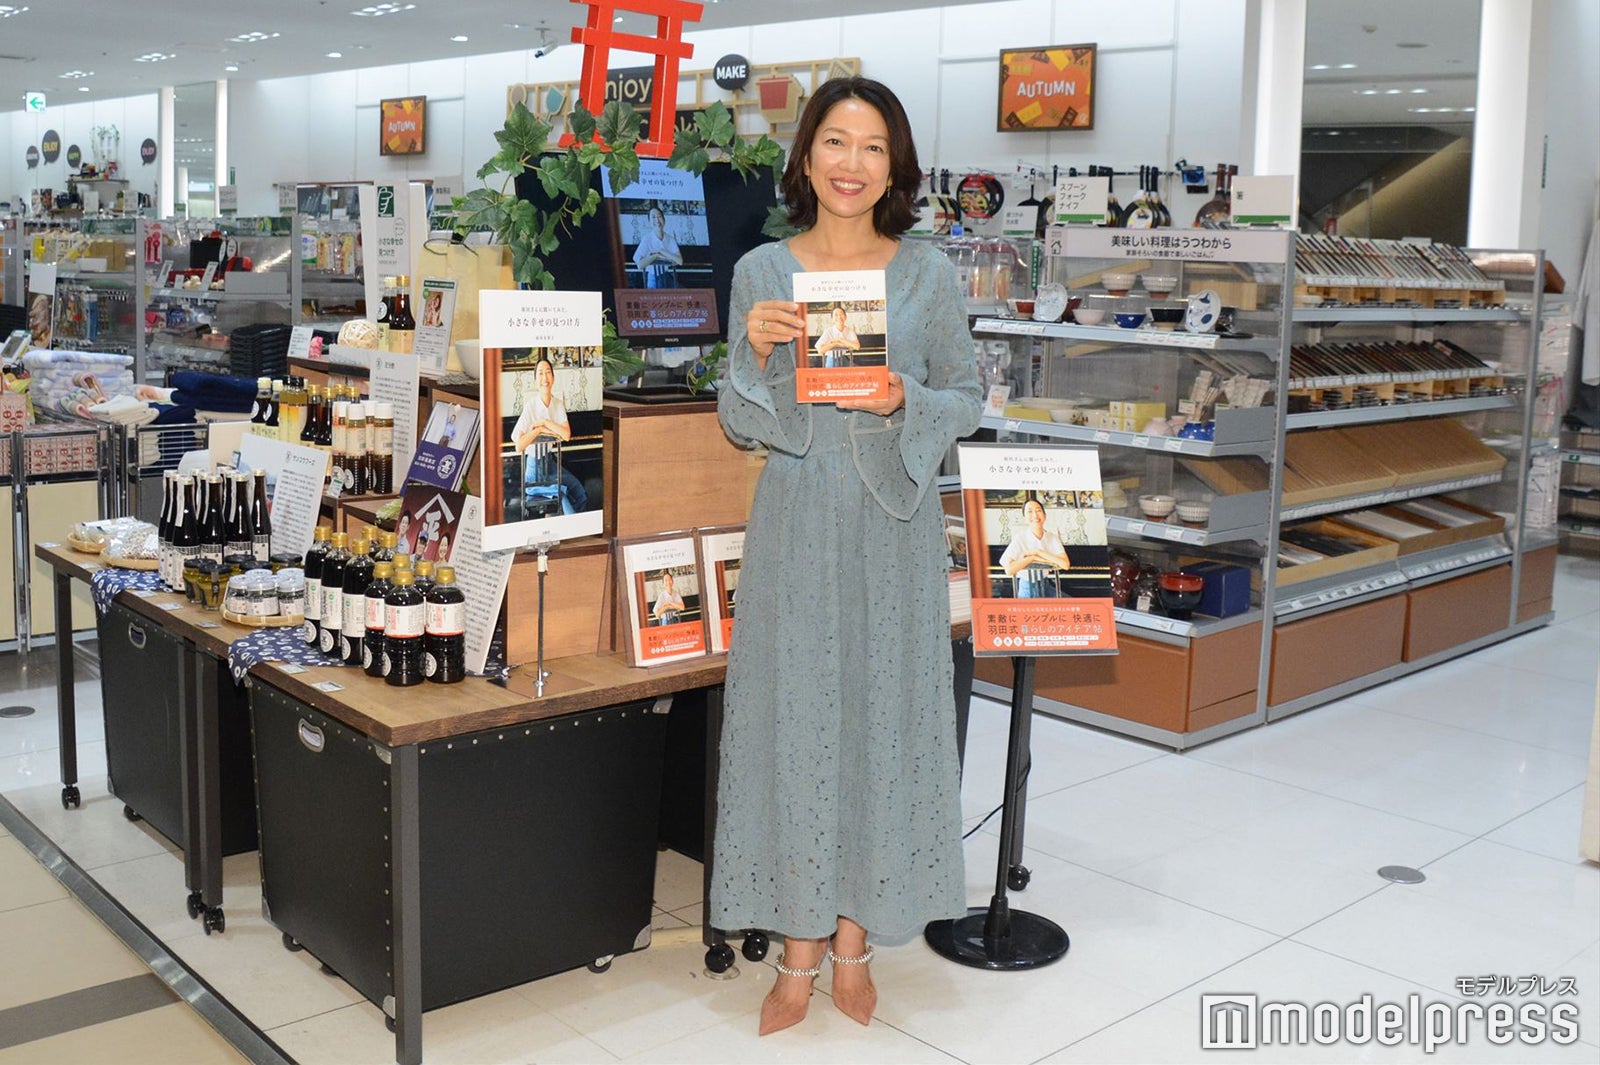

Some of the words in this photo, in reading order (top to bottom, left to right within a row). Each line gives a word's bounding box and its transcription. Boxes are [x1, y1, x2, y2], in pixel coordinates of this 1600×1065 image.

[716, 64, 746, 80] MAKE
[605, 73, 652, 102] njoy
[1017, 79, 1076, 98] AUTUMN
[388, 120, 416, 133] AUTUMN
[641, 178, 684, 188] 幸せの見つけ方
[1060, 192, 1086, 200] フォーク
[1111, 235, 1232, 249] 美味しい料理はうつわから
[508, 317, 580, 328] 小さな幸せの見つけ方
[989, 465, 1073, 475] 小さな幸せの見つけ方
[987, 614, 1017, 624] 素敵に
[1023, 613, 1067, 623] シンプルに
[1072, 613, 1101, 623] 快適に
